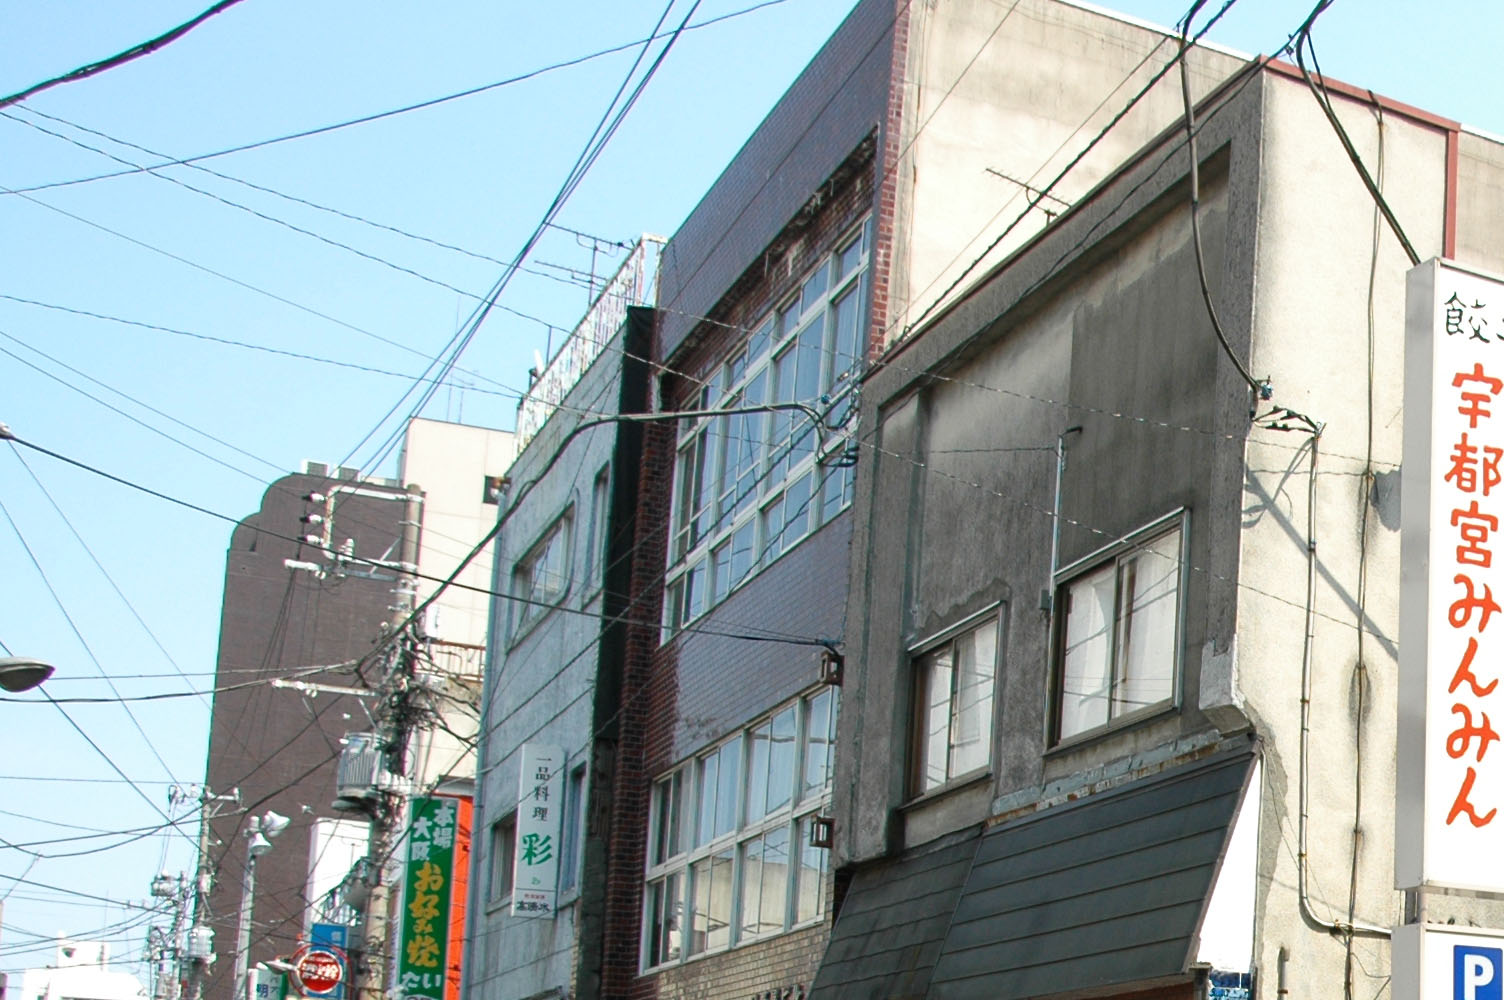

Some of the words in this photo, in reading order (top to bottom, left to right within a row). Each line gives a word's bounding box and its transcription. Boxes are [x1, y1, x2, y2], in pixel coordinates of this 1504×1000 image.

[1444, 362, 1504, 828] 宇都宮みんみん
[532, 756, 552, 822] 一品料理
[411, 816, 432, 860] 大阪
[432, 806, 455, 849] 本場
[520, 832, 552, 866] 彩
[406, 861, 444, 968] お好み焼
